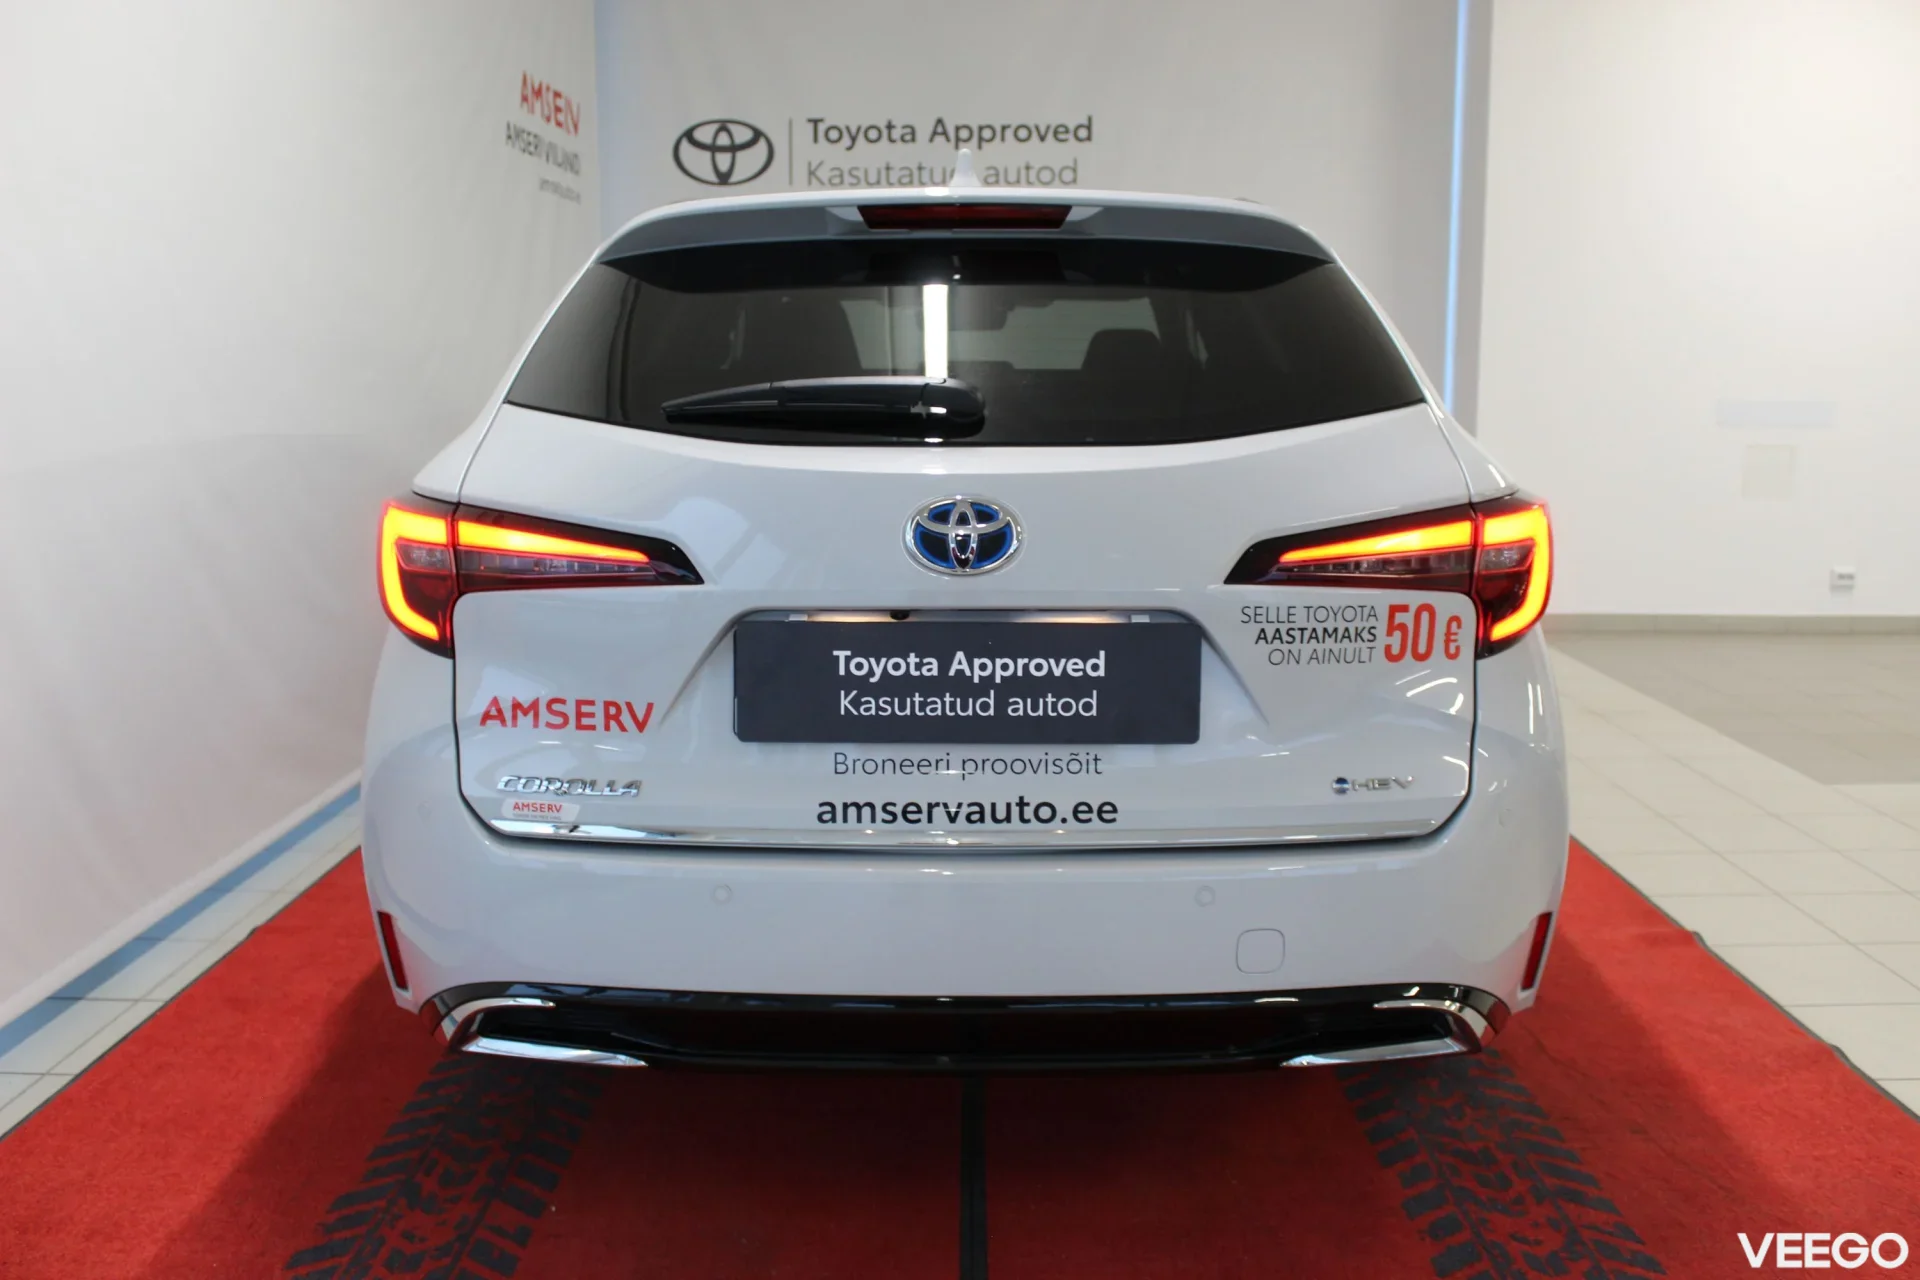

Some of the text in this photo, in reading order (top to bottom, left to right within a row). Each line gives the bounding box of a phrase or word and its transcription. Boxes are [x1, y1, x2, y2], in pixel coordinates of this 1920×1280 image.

[806, 115, 1094, 151] Toyota Approved
[806, 157, 1079, 187] Kasutatu autod
[1241, 605, 1379, 624] SELLE TOYOTA
[1255, 626, 1377, 645] AASTAMAKS
[1384, 602, 1437, 663] 50
[832, 650, 1107, 684] Toyota Approved
[1268, 647, 1377, 666] ON AINULT
[479, 695, 655, 734] AMSERV
[839, 690, 1099, 717] Kasutatud autod
[833, 751, 1103, 781] Broneeri proovisõit
[496, 775, 643, 798] COROLLA
[1351, 776, 1414, 792] HEV
[512, 801, 563, 813] AMSERV
[816, 795, 1119, 825] amservauto.ee
